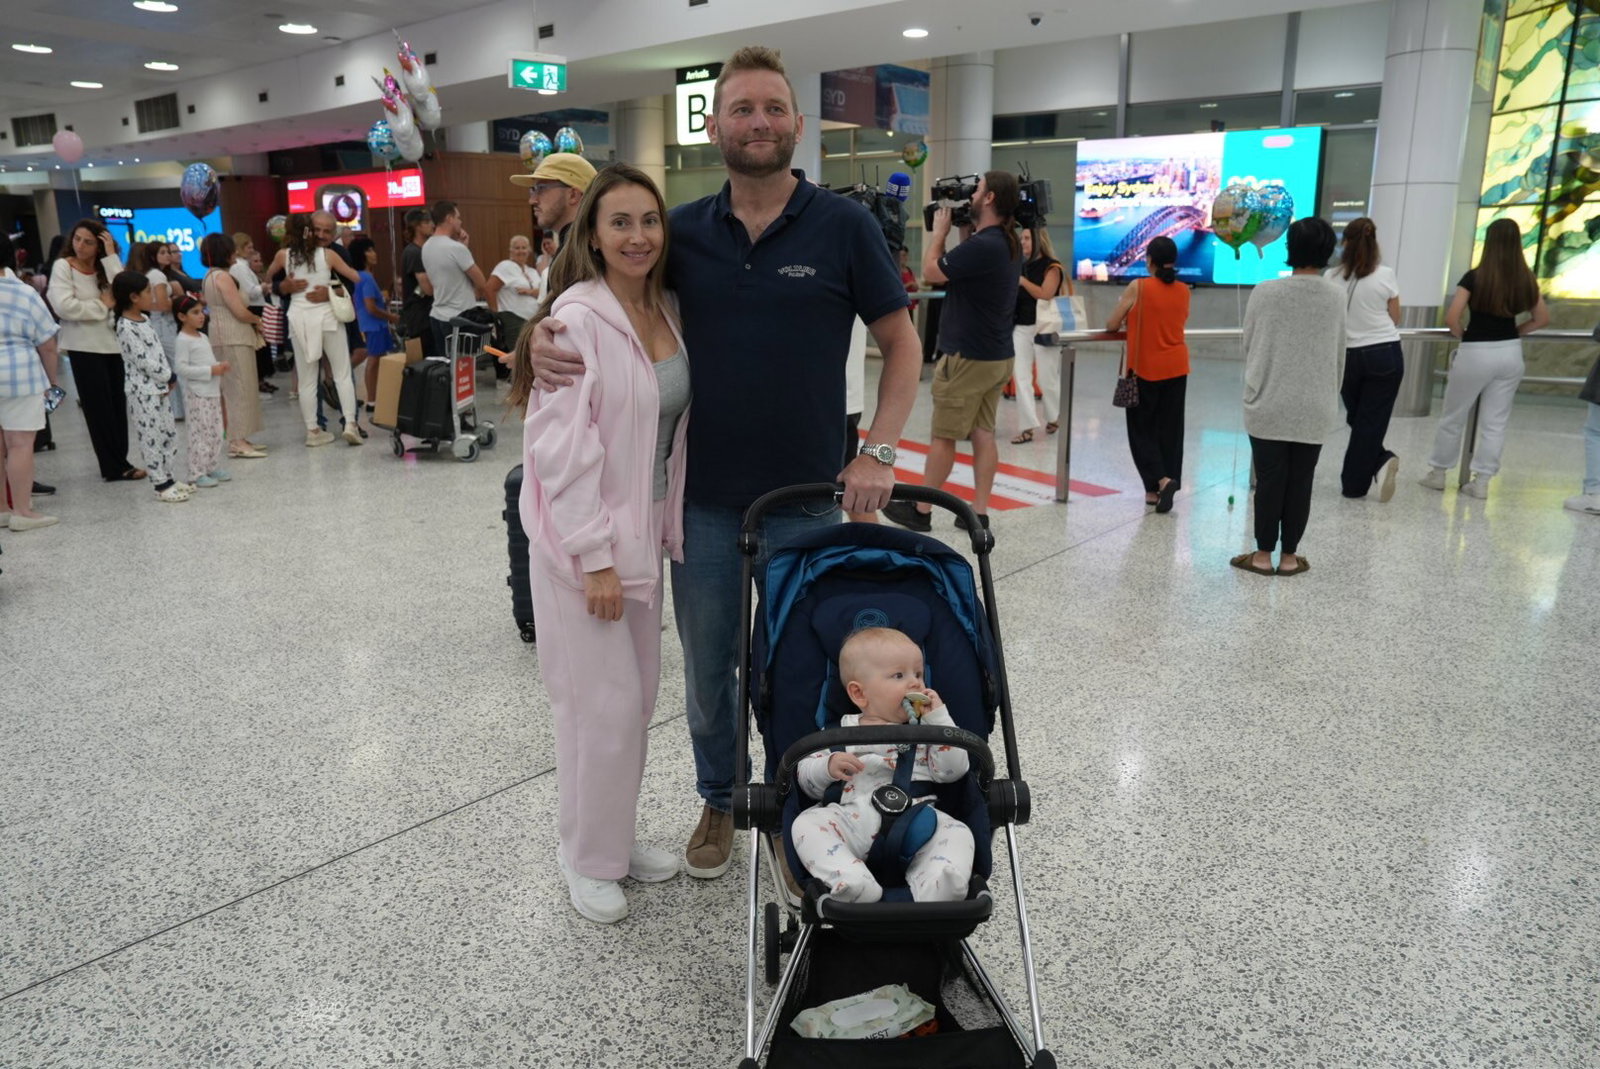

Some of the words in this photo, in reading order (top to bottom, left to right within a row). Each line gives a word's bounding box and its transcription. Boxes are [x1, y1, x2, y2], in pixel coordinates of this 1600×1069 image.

[685, 68, 709, 80] Arrivals
[688, 94, 706, 133] B
[1084, 181, 1117, 197] Enjoy
[100, 207, 133, 218] OPTUS
[166, 227, 195, 251] $25
